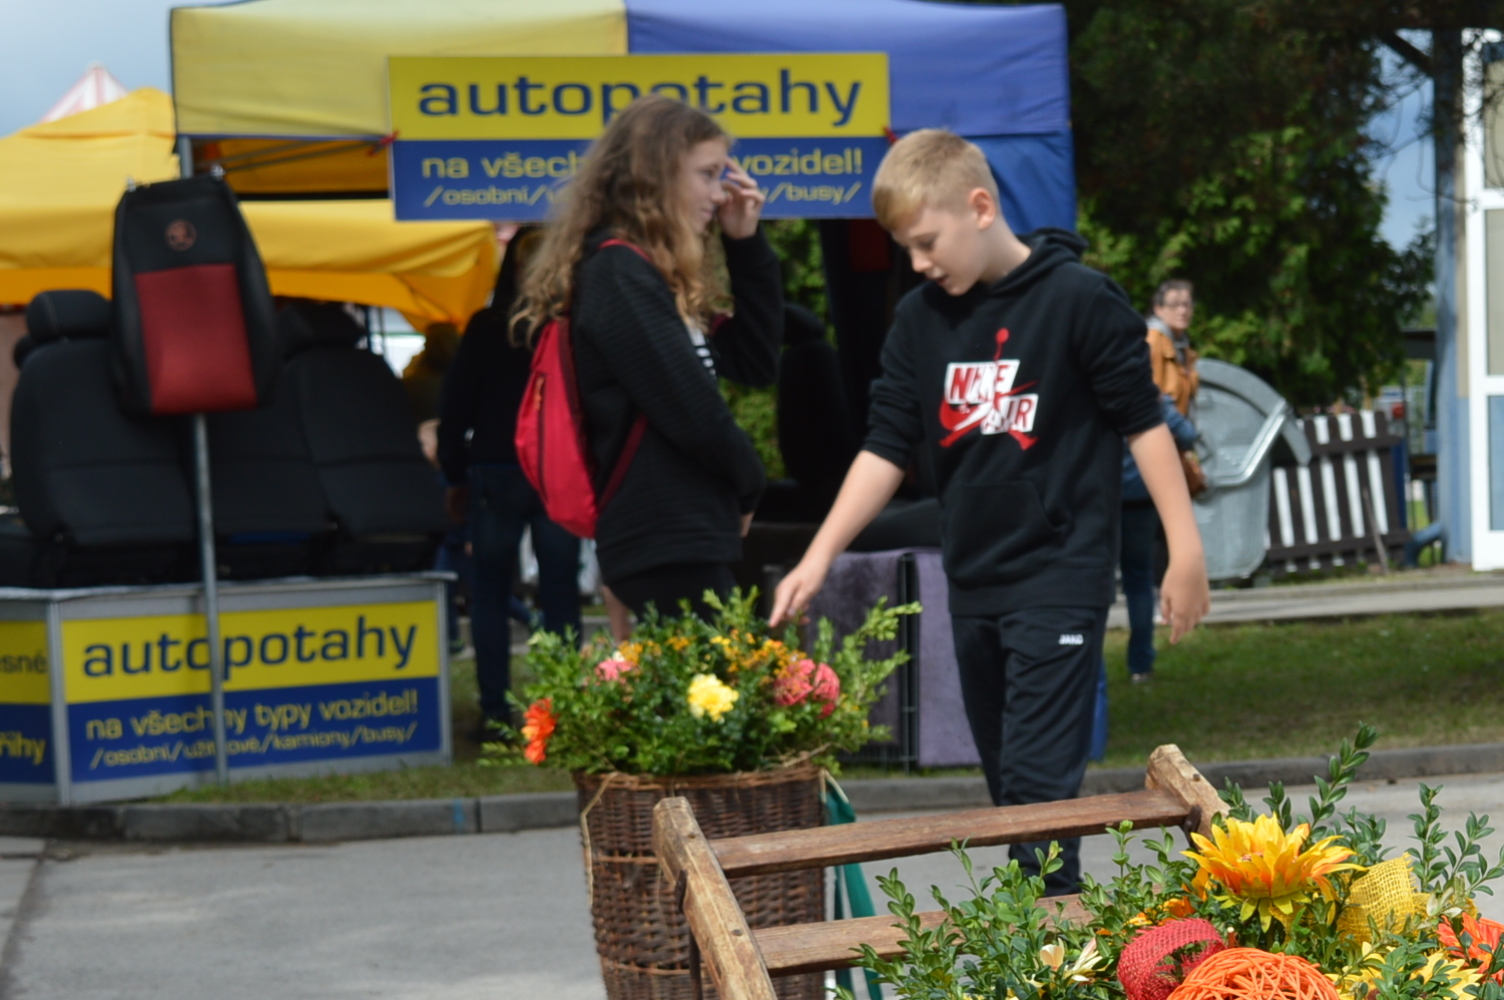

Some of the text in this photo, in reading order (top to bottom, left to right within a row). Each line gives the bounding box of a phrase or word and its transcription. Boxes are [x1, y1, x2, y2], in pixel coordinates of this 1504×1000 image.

[422, 148, 863, 178] na všech vozidel!
[83, 615, 417, 681] autopotahy
[86, 688, 418, 741] na všechny typy vozidel!
